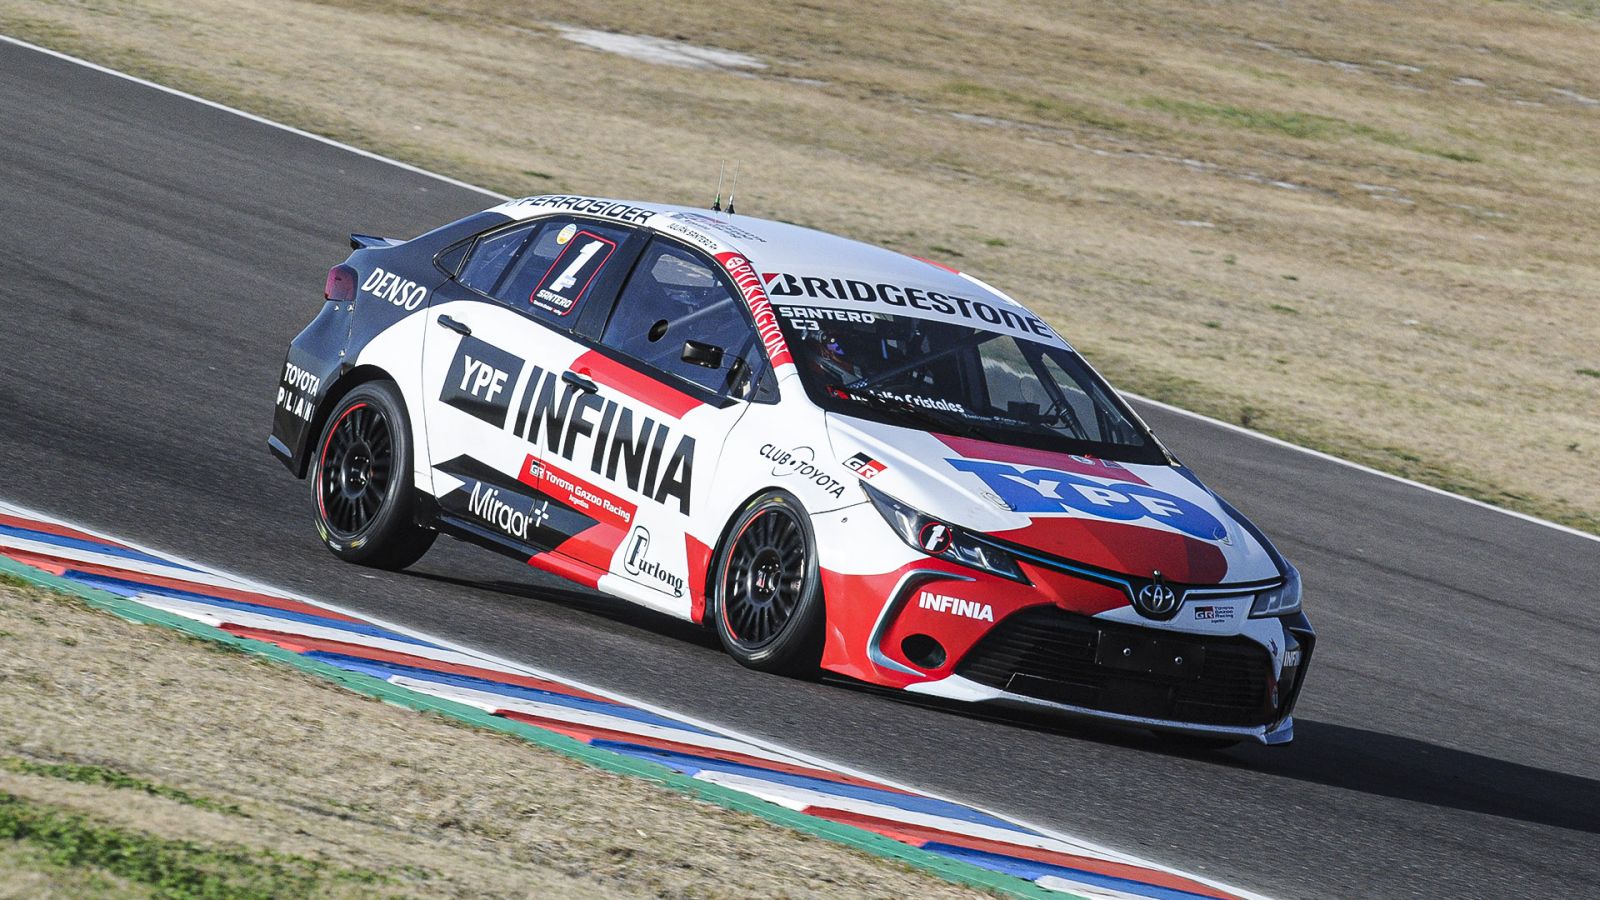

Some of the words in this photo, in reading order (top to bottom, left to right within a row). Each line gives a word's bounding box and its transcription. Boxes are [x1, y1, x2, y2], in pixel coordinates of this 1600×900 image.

[548, 240, 605, 293] 1
[361, 267, 427, 311] DENSO
[536, 288, 573, 309] SANTERO
[762, 272, 1054, 339] BRIDGESTONE
[730, 265, 789, 361] PILKINGTON
[780, 306, 876, 324] SANTERO
[790, 319, 820, 331] C3
[283, 362, 320, 397] TOYOTA
[459, 354, 509, 402] YPF
[513, 365, 696, 517] INFINIA
[759, 443, 792, 465] CLUB
[793, 460, 846, 499] TOYOTA
[842, 454, 884, 480] GR
[545, 470, 575, 493] TOYOTA
[574, 486, 602, 506] GAZOO
[602, 499, 631, 523] Racing
[925, 524, 946, 551] 1
[626, 534, 685, 598] Furlong
[919, 591, 994, 623] INFINIA
[1195, 607, 1214, 619] GR
